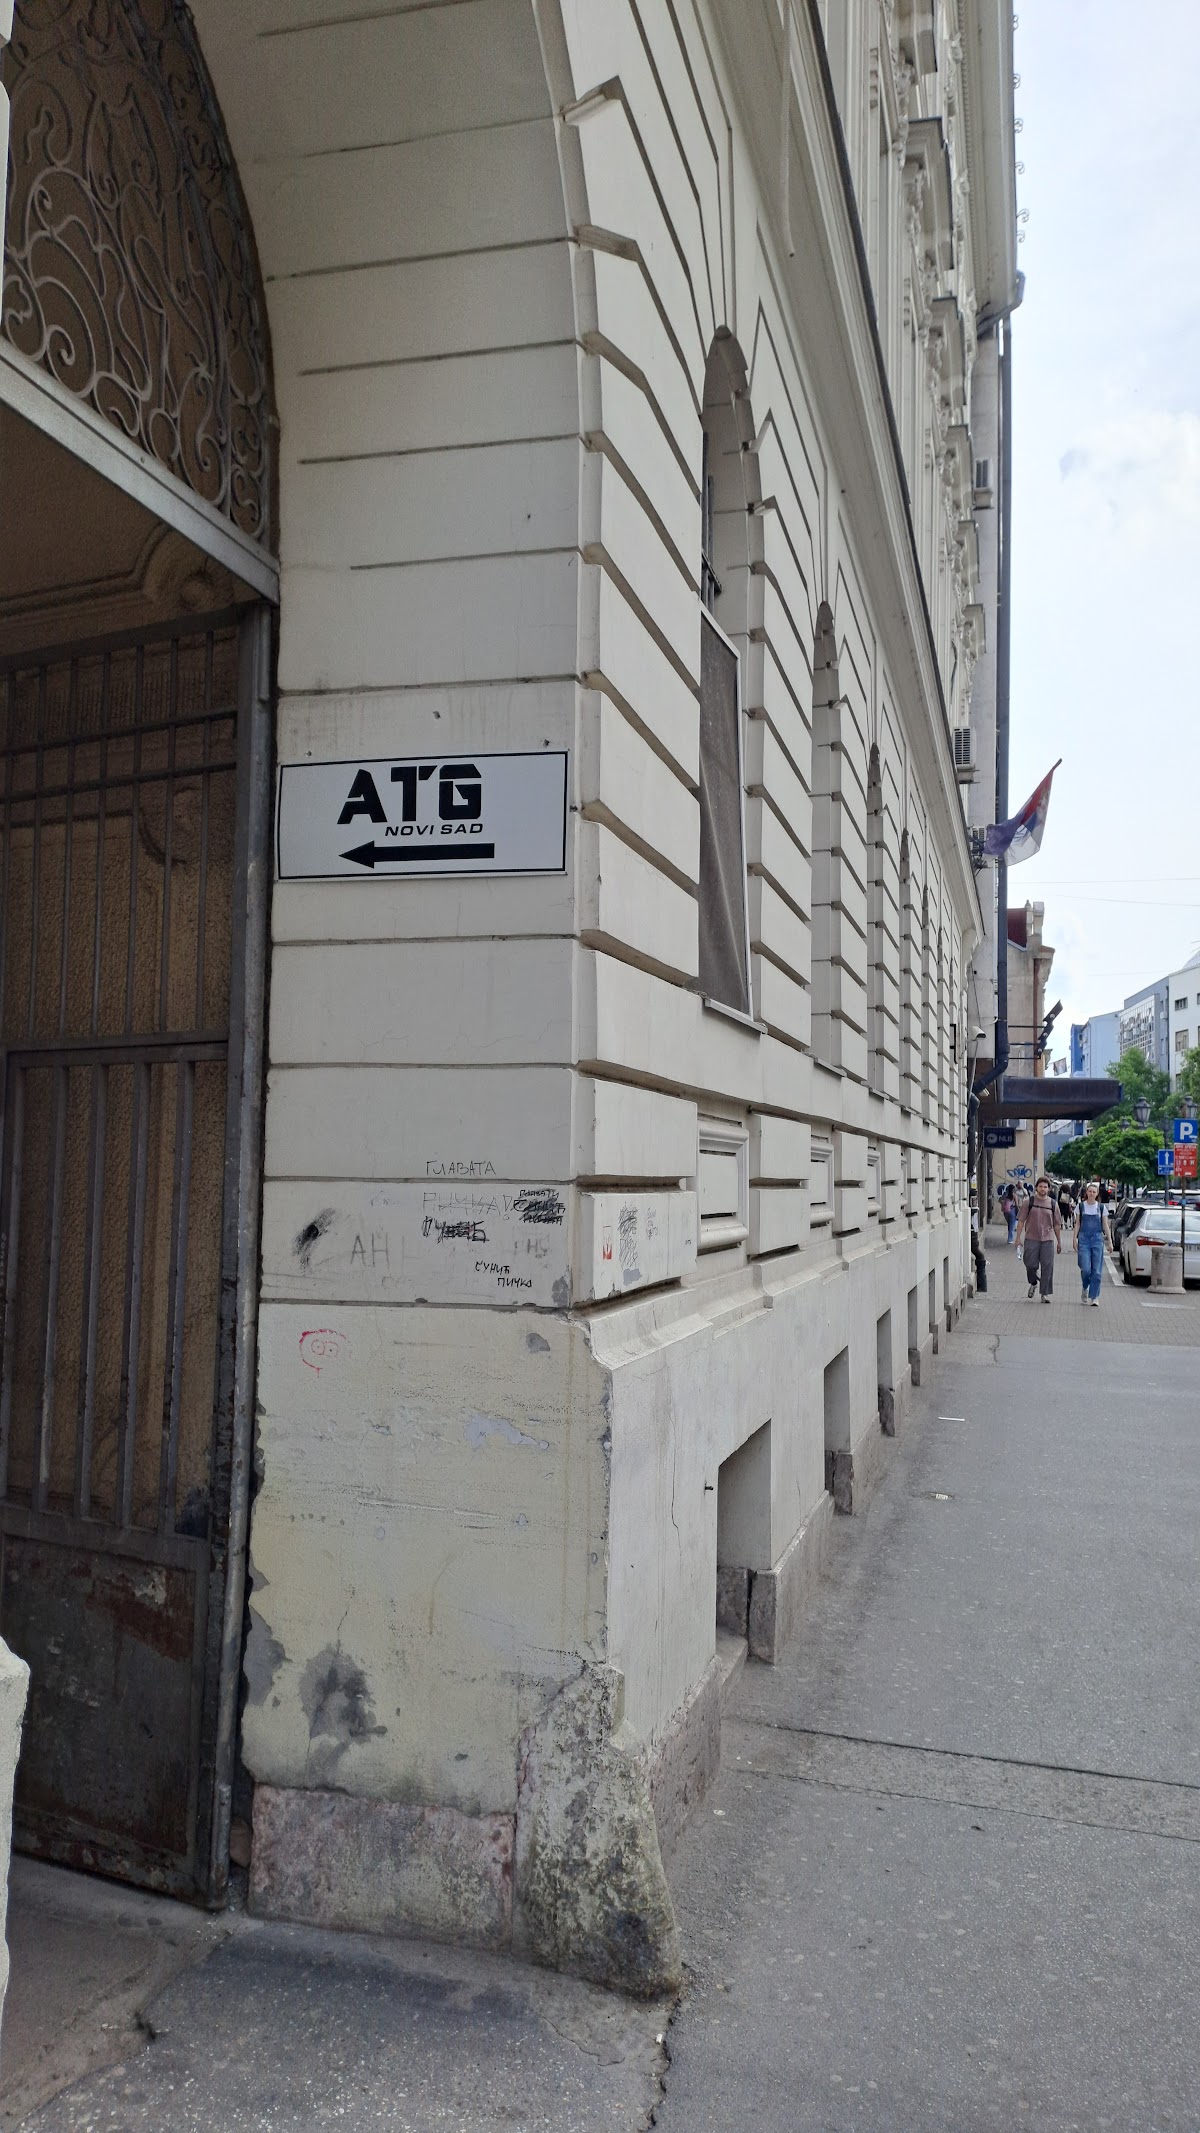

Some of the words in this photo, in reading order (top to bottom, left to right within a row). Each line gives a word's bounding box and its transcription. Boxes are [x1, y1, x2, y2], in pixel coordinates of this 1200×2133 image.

[337, 764, 482, 825] ATG
[385, 825, 434, 836] NOVI
[441, 824, 484, 835] SAD
[1179, 1121, 1194, 1141] P
